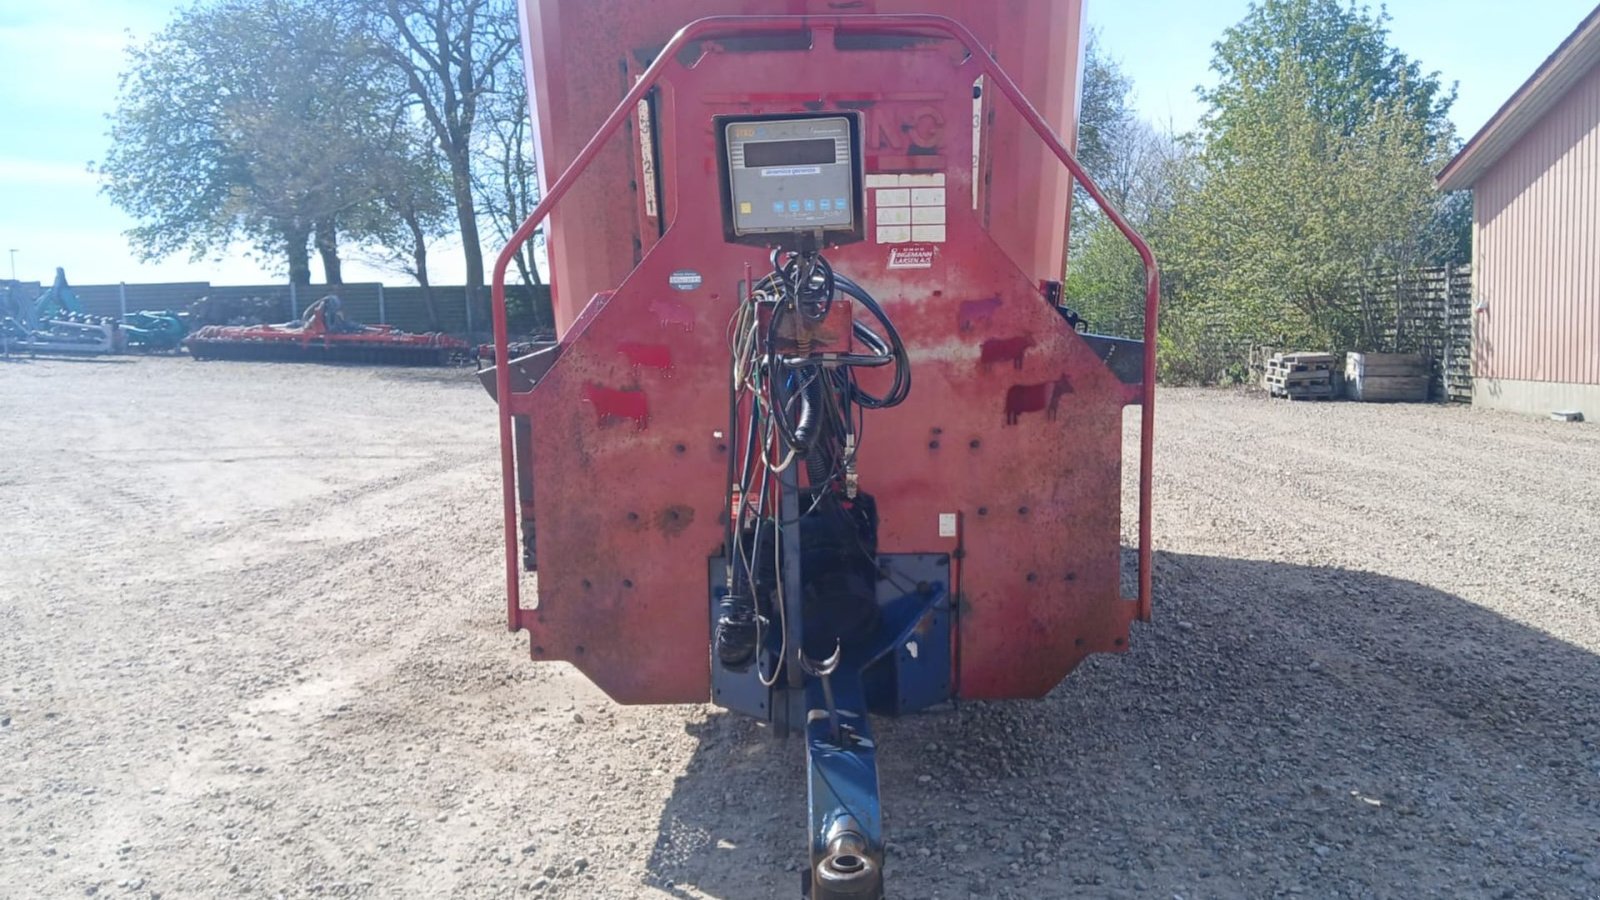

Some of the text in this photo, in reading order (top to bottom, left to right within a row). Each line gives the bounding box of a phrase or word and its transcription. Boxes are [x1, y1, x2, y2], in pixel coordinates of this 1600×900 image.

[972, 114, 980, 129] 3
[643, 160, 652, 174] 2
[647, 200, 655, 215] 1
